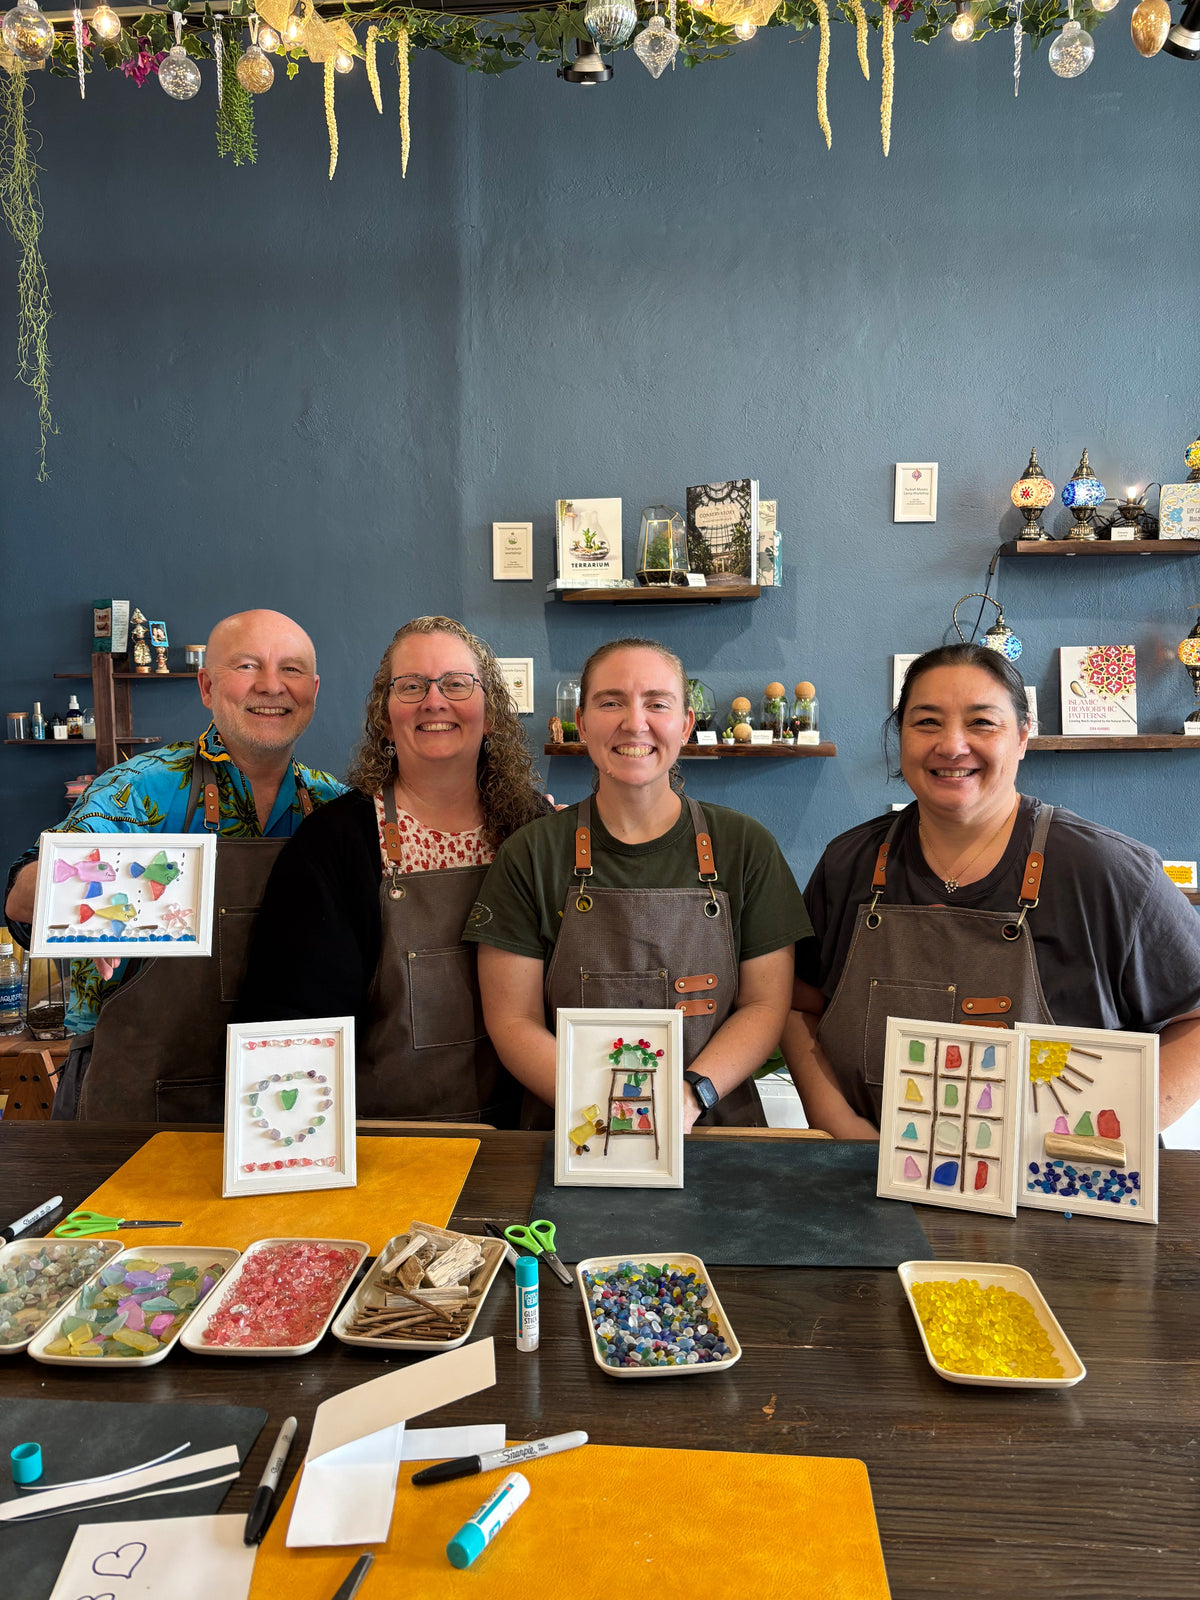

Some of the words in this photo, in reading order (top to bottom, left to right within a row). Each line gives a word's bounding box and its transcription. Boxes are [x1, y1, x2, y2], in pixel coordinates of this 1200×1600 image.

[524, 1310, 537, 1318] GLUE
[524, 1317, 537, 1325] STICK
[500, 1445, 537, 1462] Sharpie
